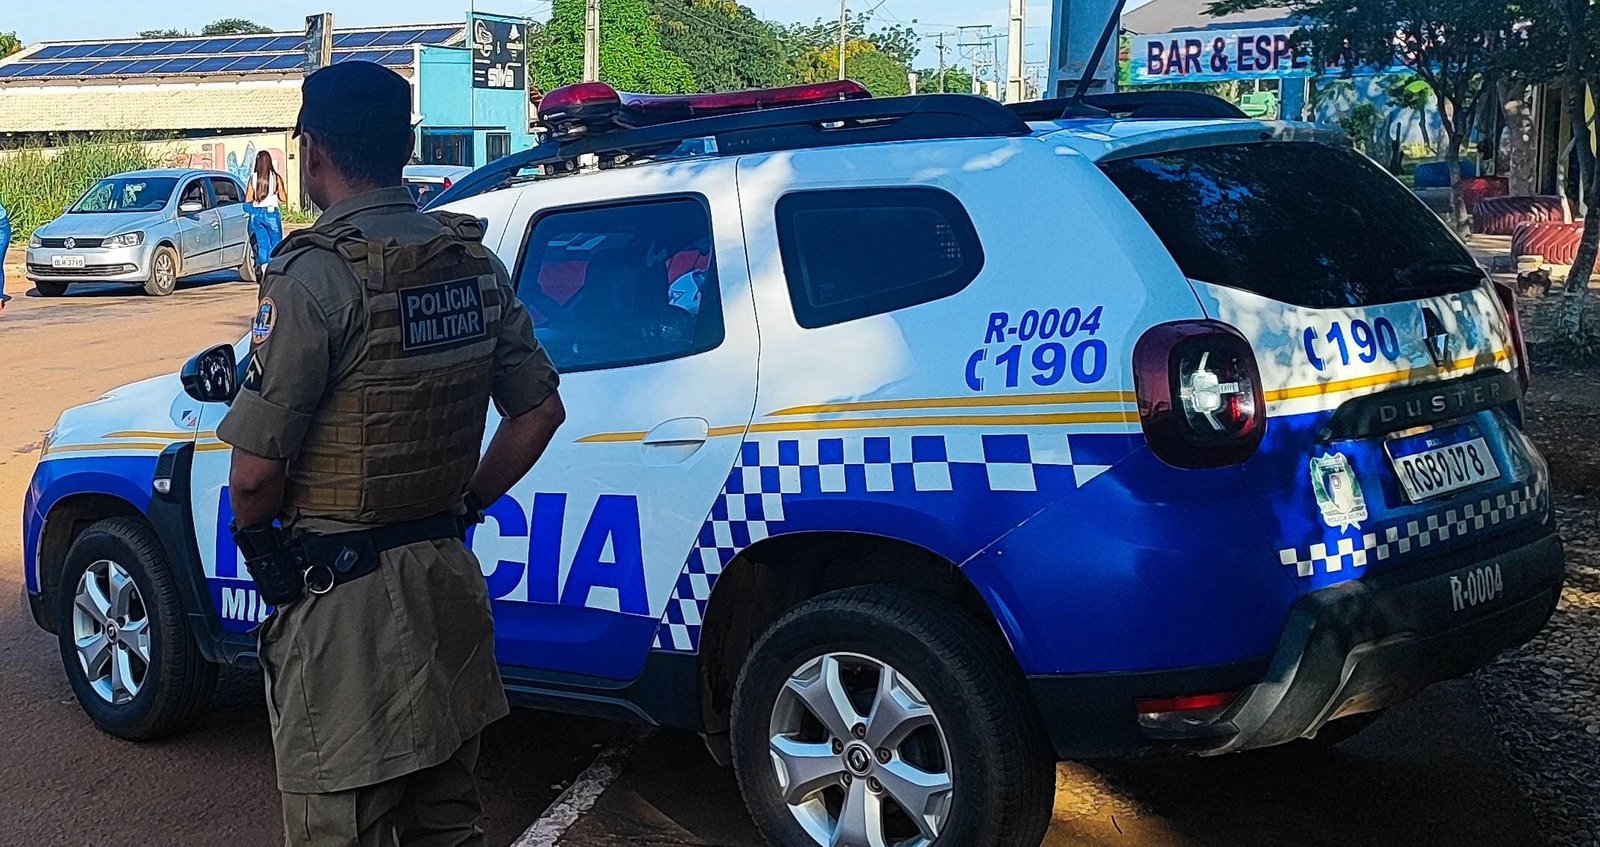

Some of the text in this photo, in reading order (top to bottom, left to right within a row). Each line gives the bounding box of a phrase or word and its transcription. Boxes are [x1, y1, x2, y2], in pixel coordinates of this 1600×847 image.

[1147, 39, 1203, 75] BAR
[1210, 36, 1229, 73] &
[407, 285, 478, 318] POLÍCIA
[409, 310, 480, 344] MILITAR
[984, 305, 1104, 344] R-0004
[1326, 316, 1400, 367] 190
[995, 338, 1108, 388] 190
[1379, 383, 1500, 423] DUSTER
[1403, 444, 1485, 494] RSB9J78
[221, 587, 270, 623] MIL
[1450, 563, 1503, 612] R-0004
